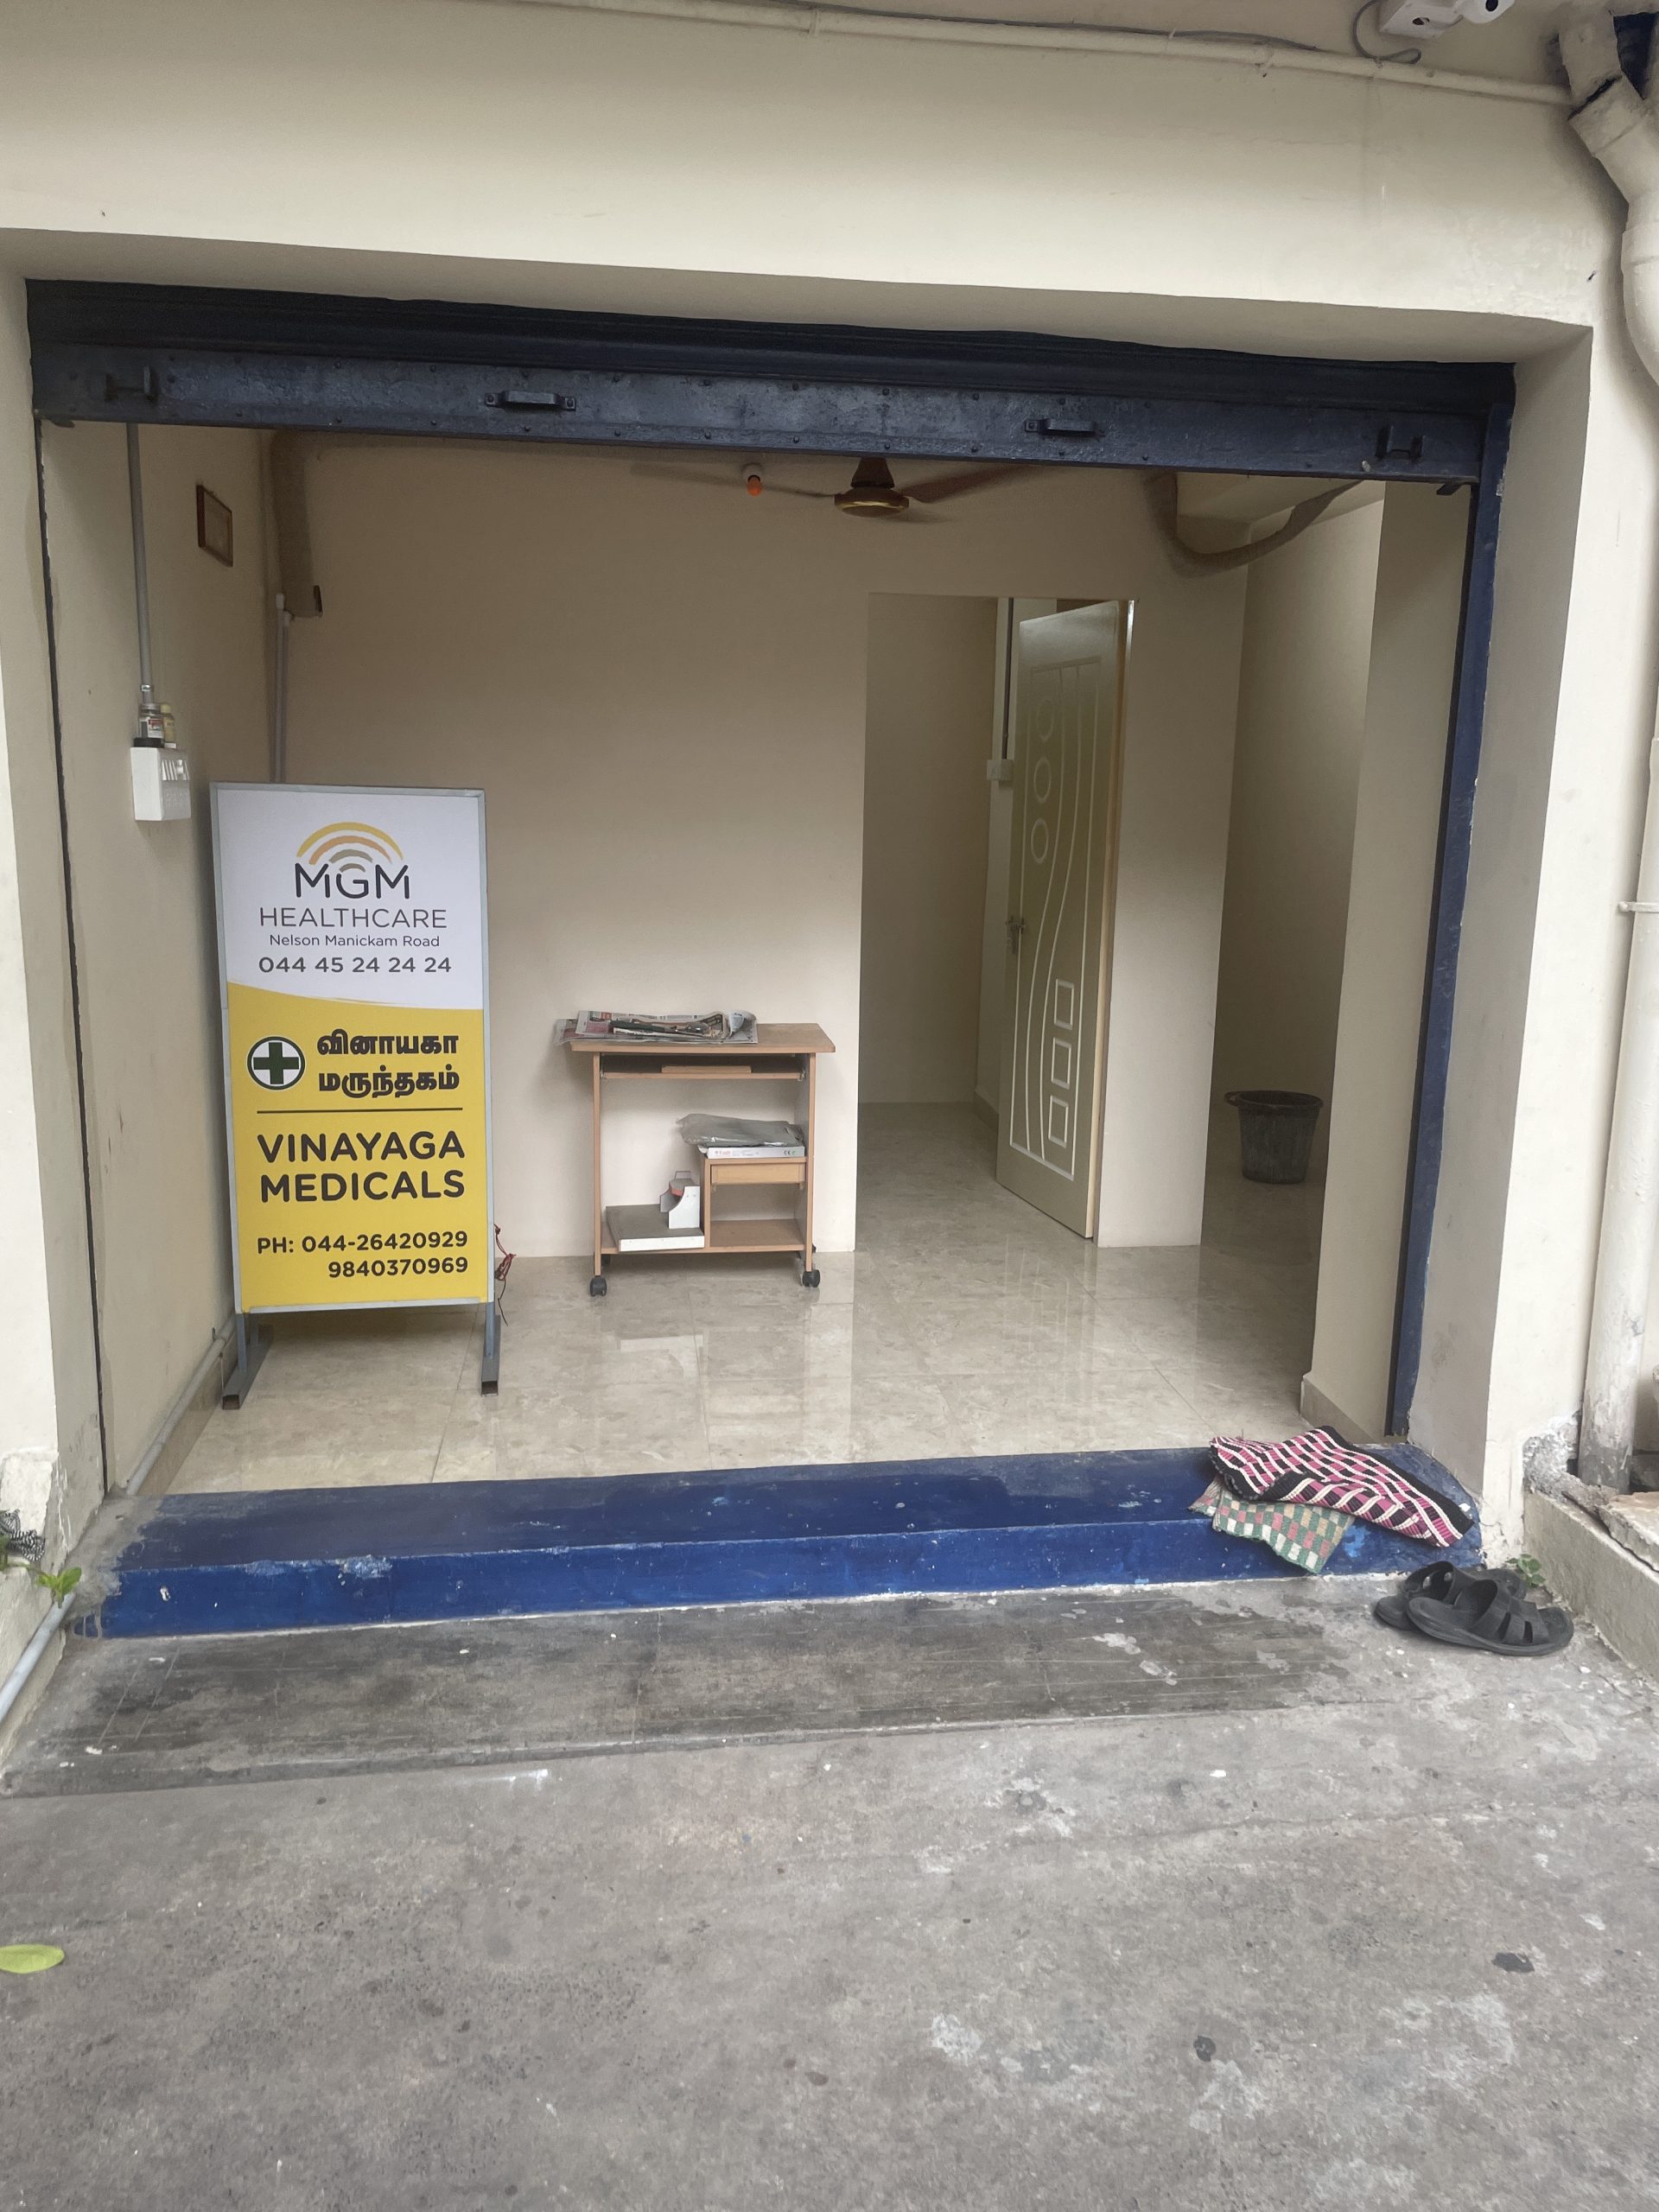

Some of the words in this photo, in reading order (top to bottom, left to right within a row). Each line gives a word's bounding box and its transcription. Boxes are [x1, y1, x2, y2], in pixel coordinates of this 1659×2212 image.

[294, 862, 410, 899] MGM
[259, 907, 448, 929] HEALTHCARE
[270, 934, 320, 946] Nelson
[325, 935, 397, 947] Manickam
[403, 935, 440, 947] Road
[258, 957, 306, 973] 044
[315, 957, 344, 973] 45
[352, 957, 380, 973] 24
[388, 957, 416, 973] 24
[423, 957, 452, 973] 24
[316, 1028, 460, 1055] வினாயகா
[318, 1063, 460, 1098] மருந்தகம்
[257, 1130, 465, 1163] VINAYAGA
[260, 1170, 465, 1204] MEDICALS
[257, 1236, 295, 1254] PH:
[302, 1230, 467, 1253] 044-26420929
[327, 1256, 468, 1279] 9840370969
